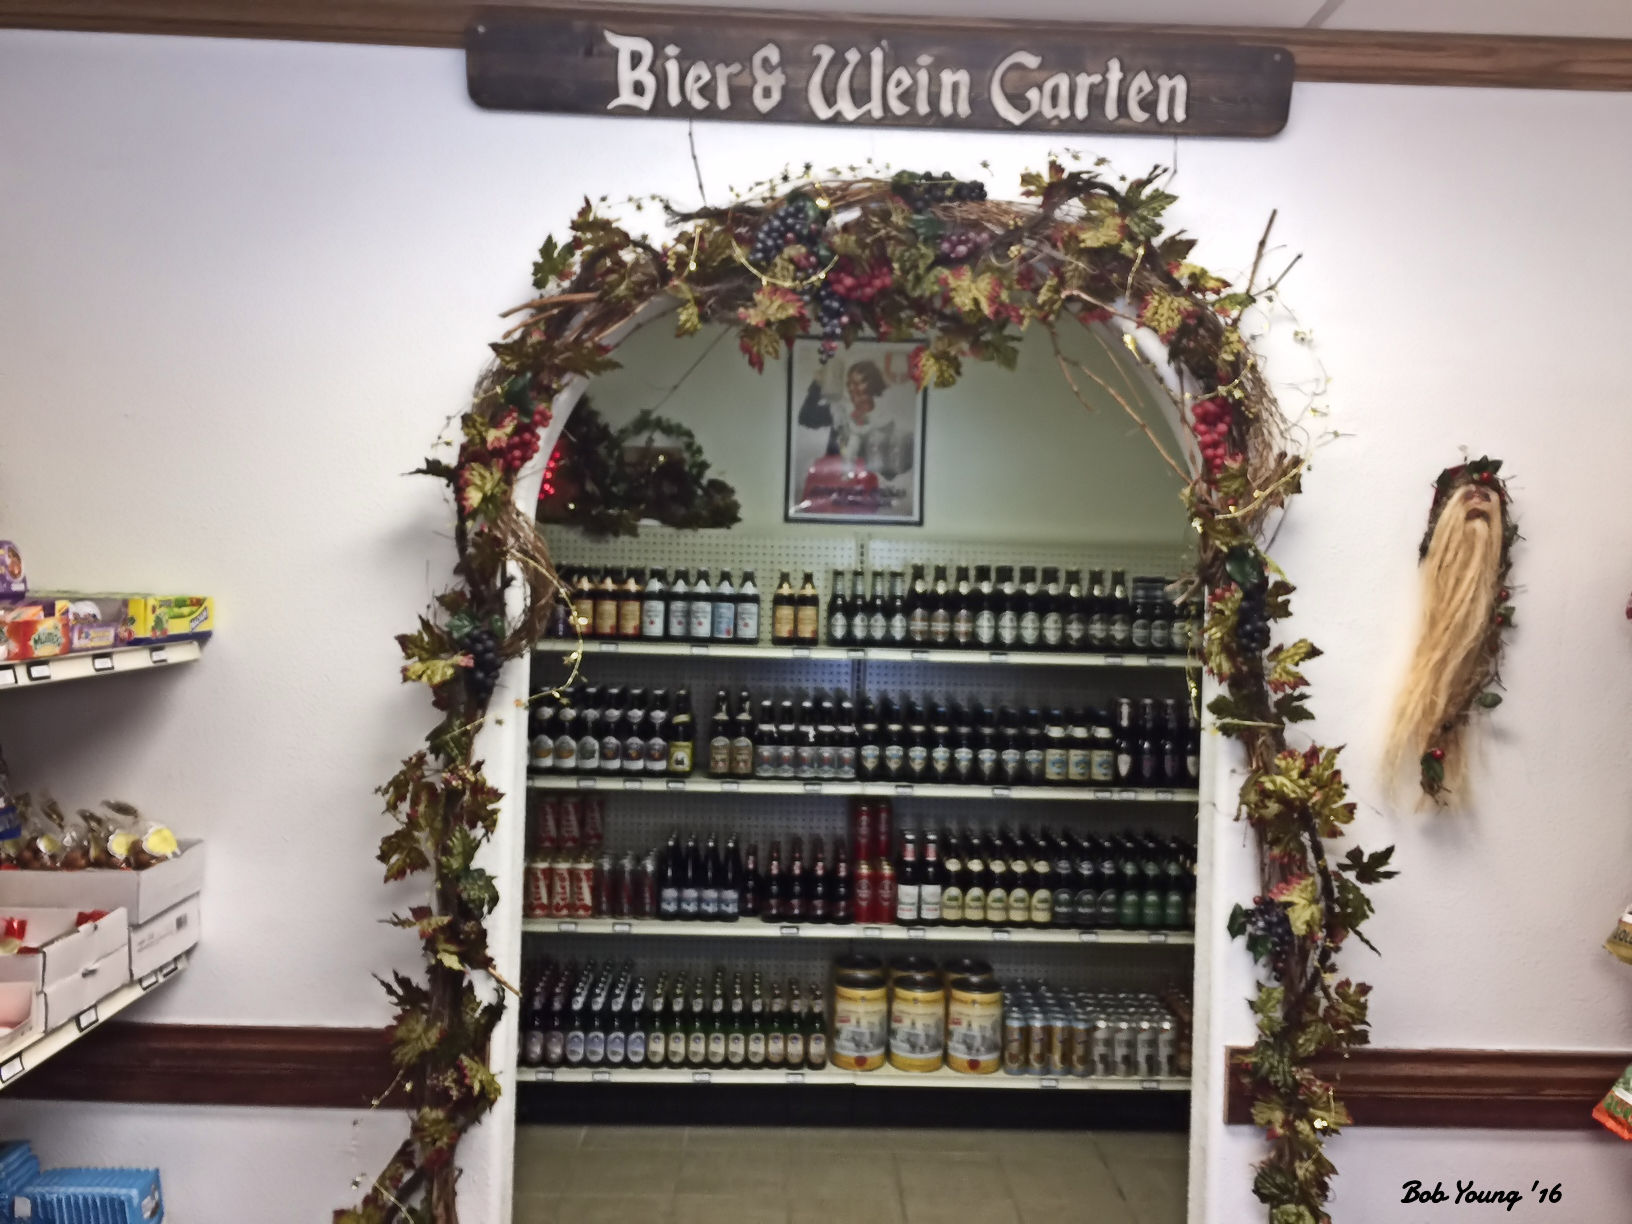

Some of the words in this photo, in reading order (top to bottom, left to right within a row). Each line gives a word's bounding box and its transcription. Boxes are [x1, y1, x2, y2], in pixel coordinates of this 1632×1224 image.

[603, 29, 744, 111] Bier
[807, 40, 972, 121] Wein
[990, 50, 1188, 125] Garten
